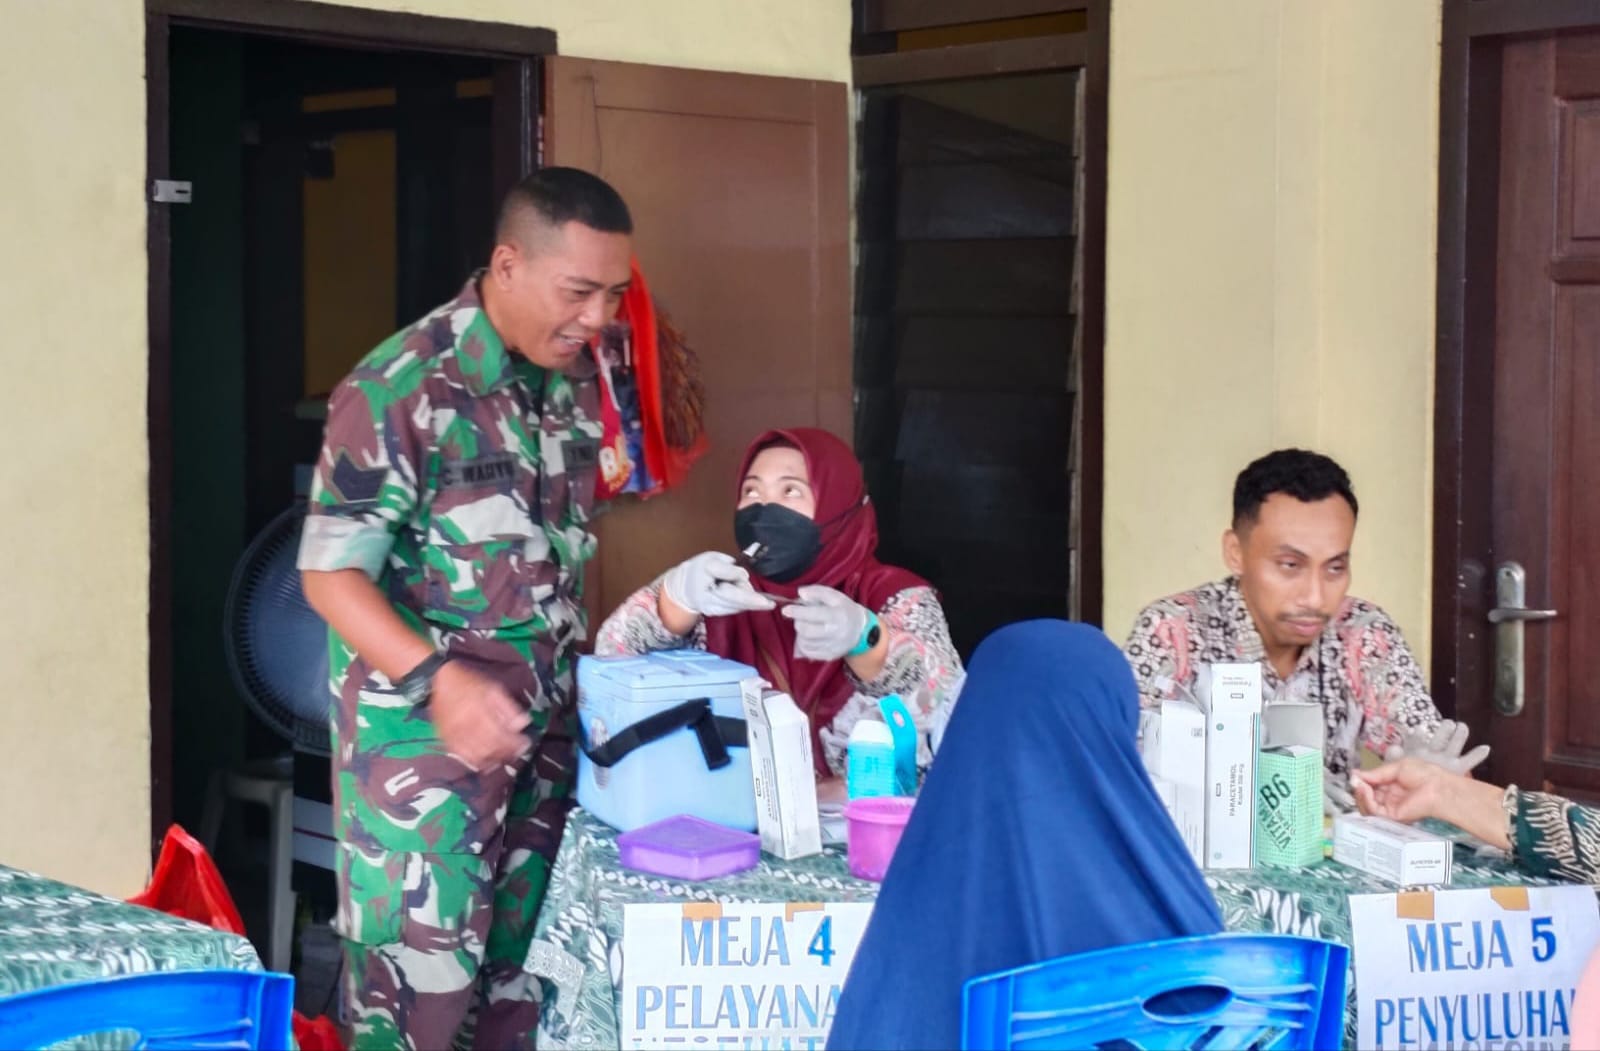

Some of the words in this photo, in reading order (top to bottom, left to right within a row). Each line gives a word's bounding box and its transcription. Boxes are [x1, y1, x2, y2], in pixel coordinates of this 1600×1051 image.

[1229, 763, 1238, 817] PARACETAMOL
[681, 916, 790, 966] MEJA
[807, 915, 836, 966] 4
[1406, 920, 1513, 972] MEJA
[1530, 917, 1557, 962] 5
[1375, 988, 1576, 1045] PENYULUHA
